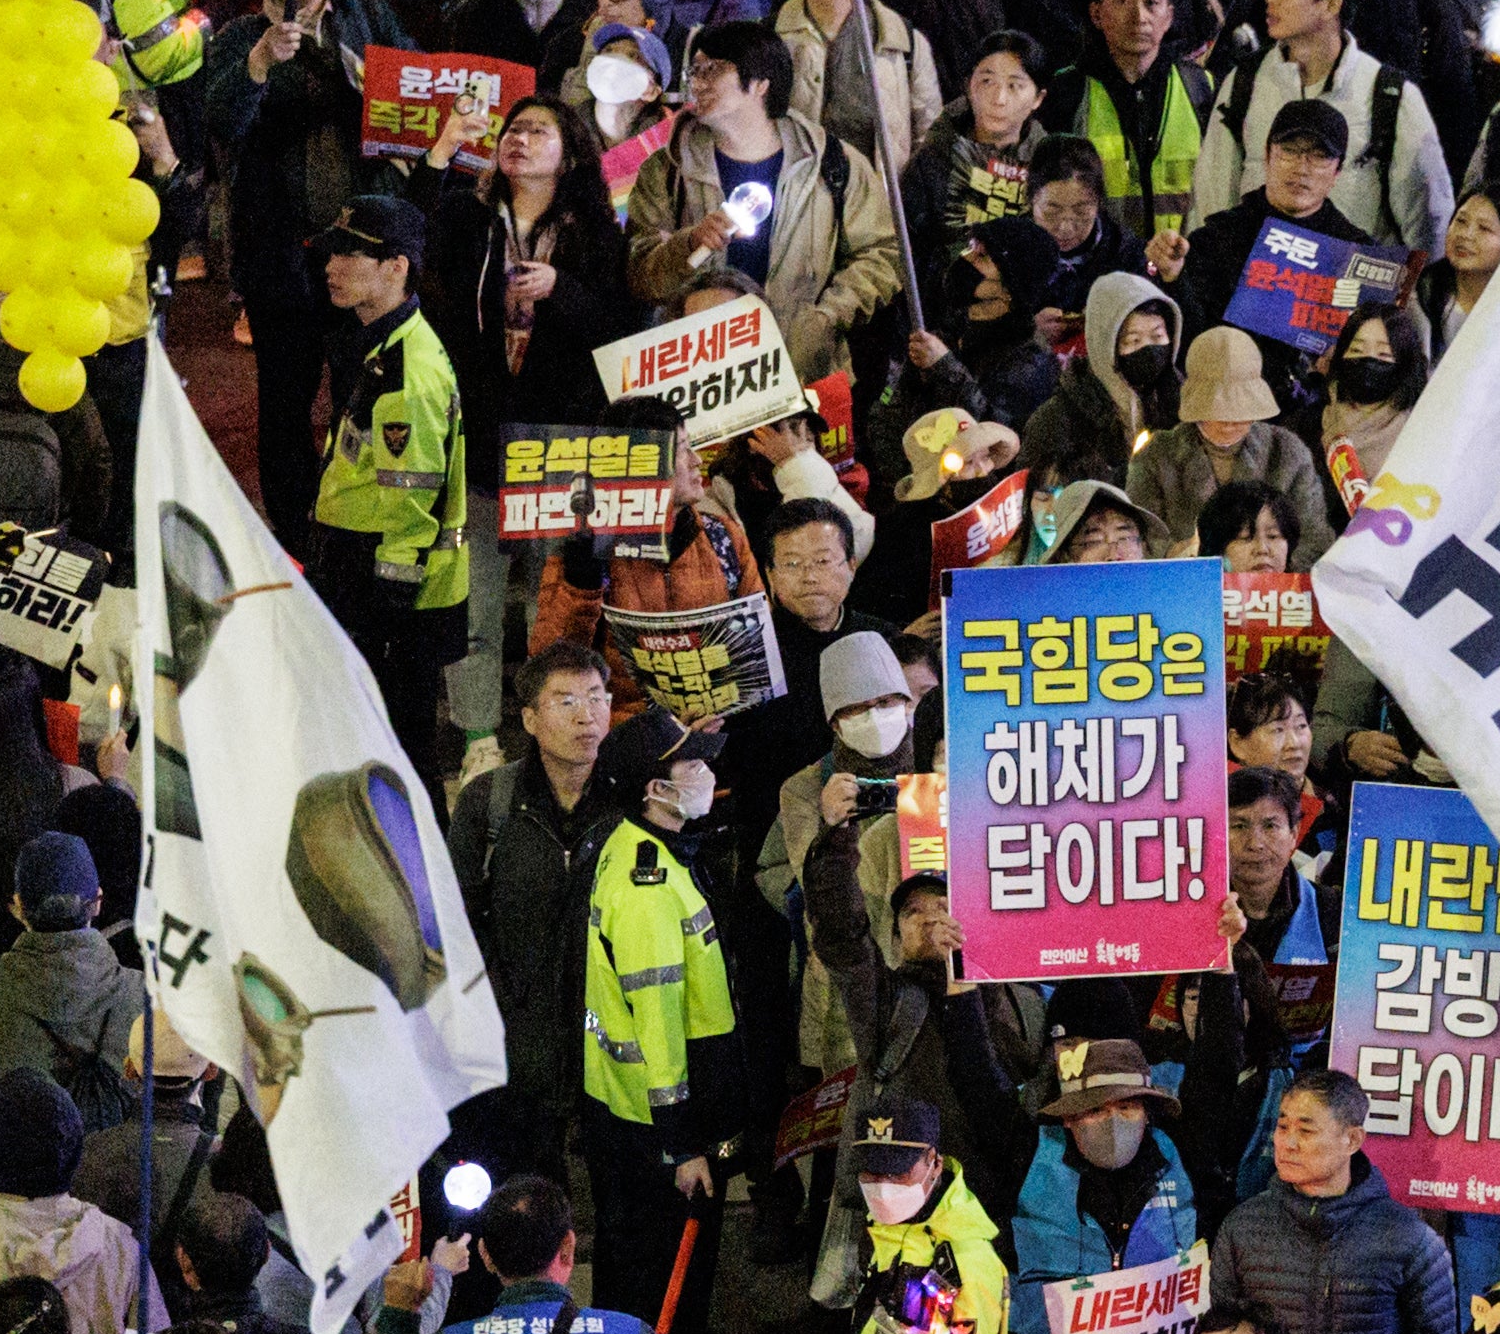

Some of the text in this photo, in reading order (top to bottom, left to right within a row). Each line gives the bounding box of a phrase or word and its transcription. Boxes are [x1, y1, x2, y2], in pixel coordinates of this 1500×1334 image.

[622, 308, 761, 392] 내란세력
[506, 436, 659, 482] 윤석열을
[961, 614, 1205, 706] 국힘당은
[986, 716, 1184, 805] 해체가
[988, 818, 1203, 909] 답이다!
[1039, 947, 1089, 967] 천안아산
[1408, 1178, 1457, 1199] 천안아산
[1069, 1265, 1202, 1334] 내란세력
